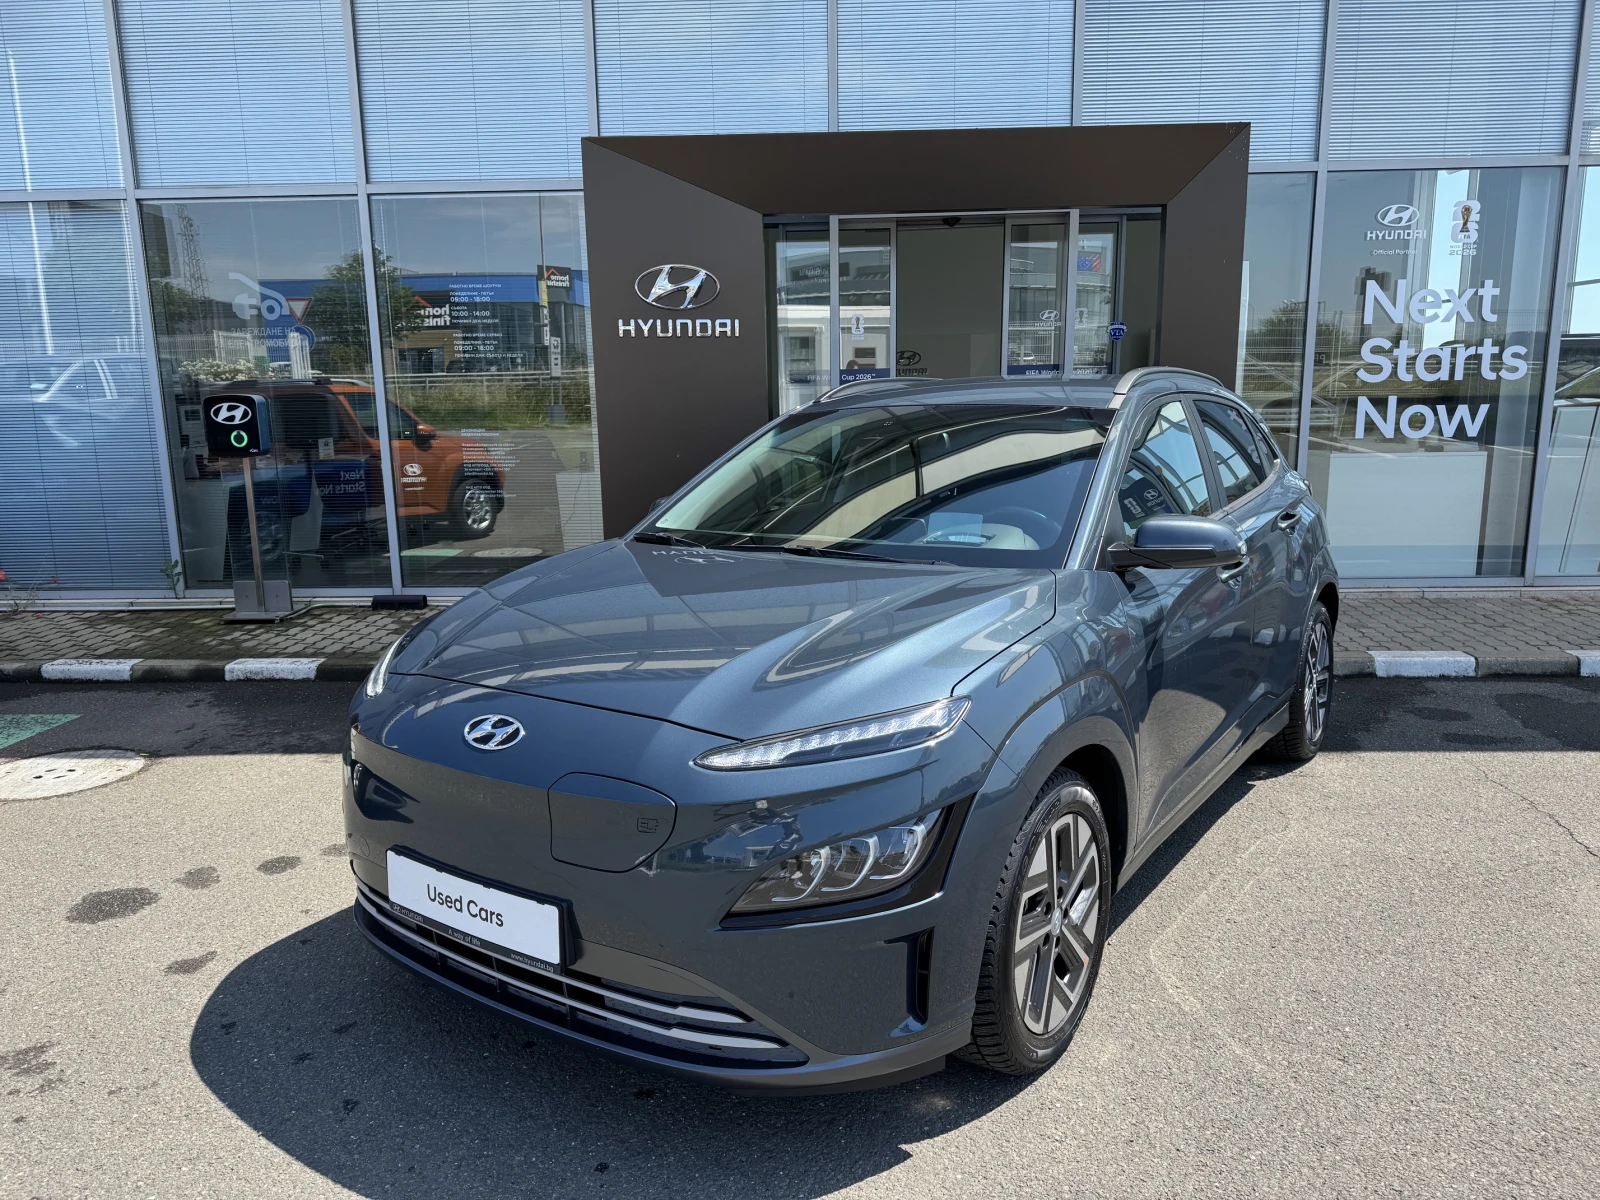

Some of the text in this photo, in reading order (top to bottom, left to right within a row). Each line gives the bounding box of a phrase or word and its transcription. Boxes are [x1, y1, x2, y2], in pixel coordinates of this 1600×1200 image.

[1366, 230, 1427, 241] HYUNDAI
[1363, 279, 1500, 325] Next
[230, 327, 283, 336] ЗАРЕЖДАНЕ
[618, 318, 740, 338] HYUNDAI
[1356, 337, 1528, 383] Starts
[1355, 395, 1490, 439] Now
[401, 908, 424, 923] HYUNDAI
[426, 883, 504, 928] Used Cars
[454, 931, 465, 942] way
[465, 934, 471, 942] of
[471, 936, 481, 947] life
[510, 953, 554, 973] www.hyundai.bg
